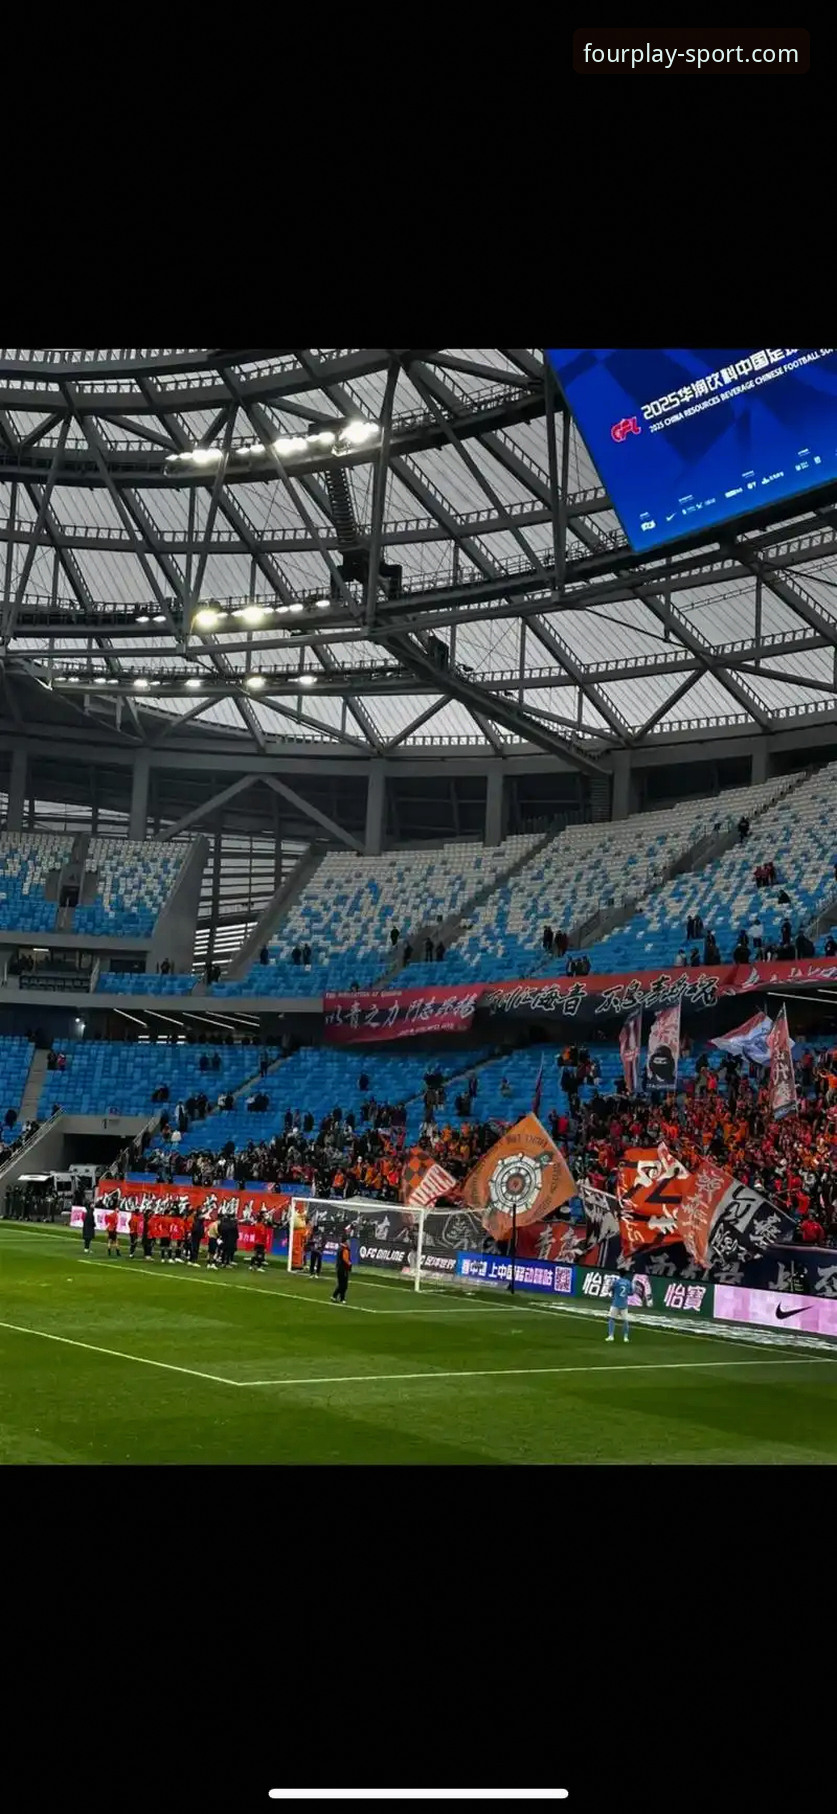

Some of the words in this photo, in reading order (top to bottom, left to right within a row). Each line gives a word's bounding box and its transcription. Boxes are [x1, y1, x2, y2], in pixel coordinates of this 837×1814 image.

[664, 412, 684, 426] CHINA
[683, 395, 721, 417] RESOURCES
[720, 379, 755, 401] BEVERAGE
[755, 366, 784, 385] CHINESE
[783, 351, 820, 372] FOOTBALL
[663, 1283, 707, 1312] 怡寶
